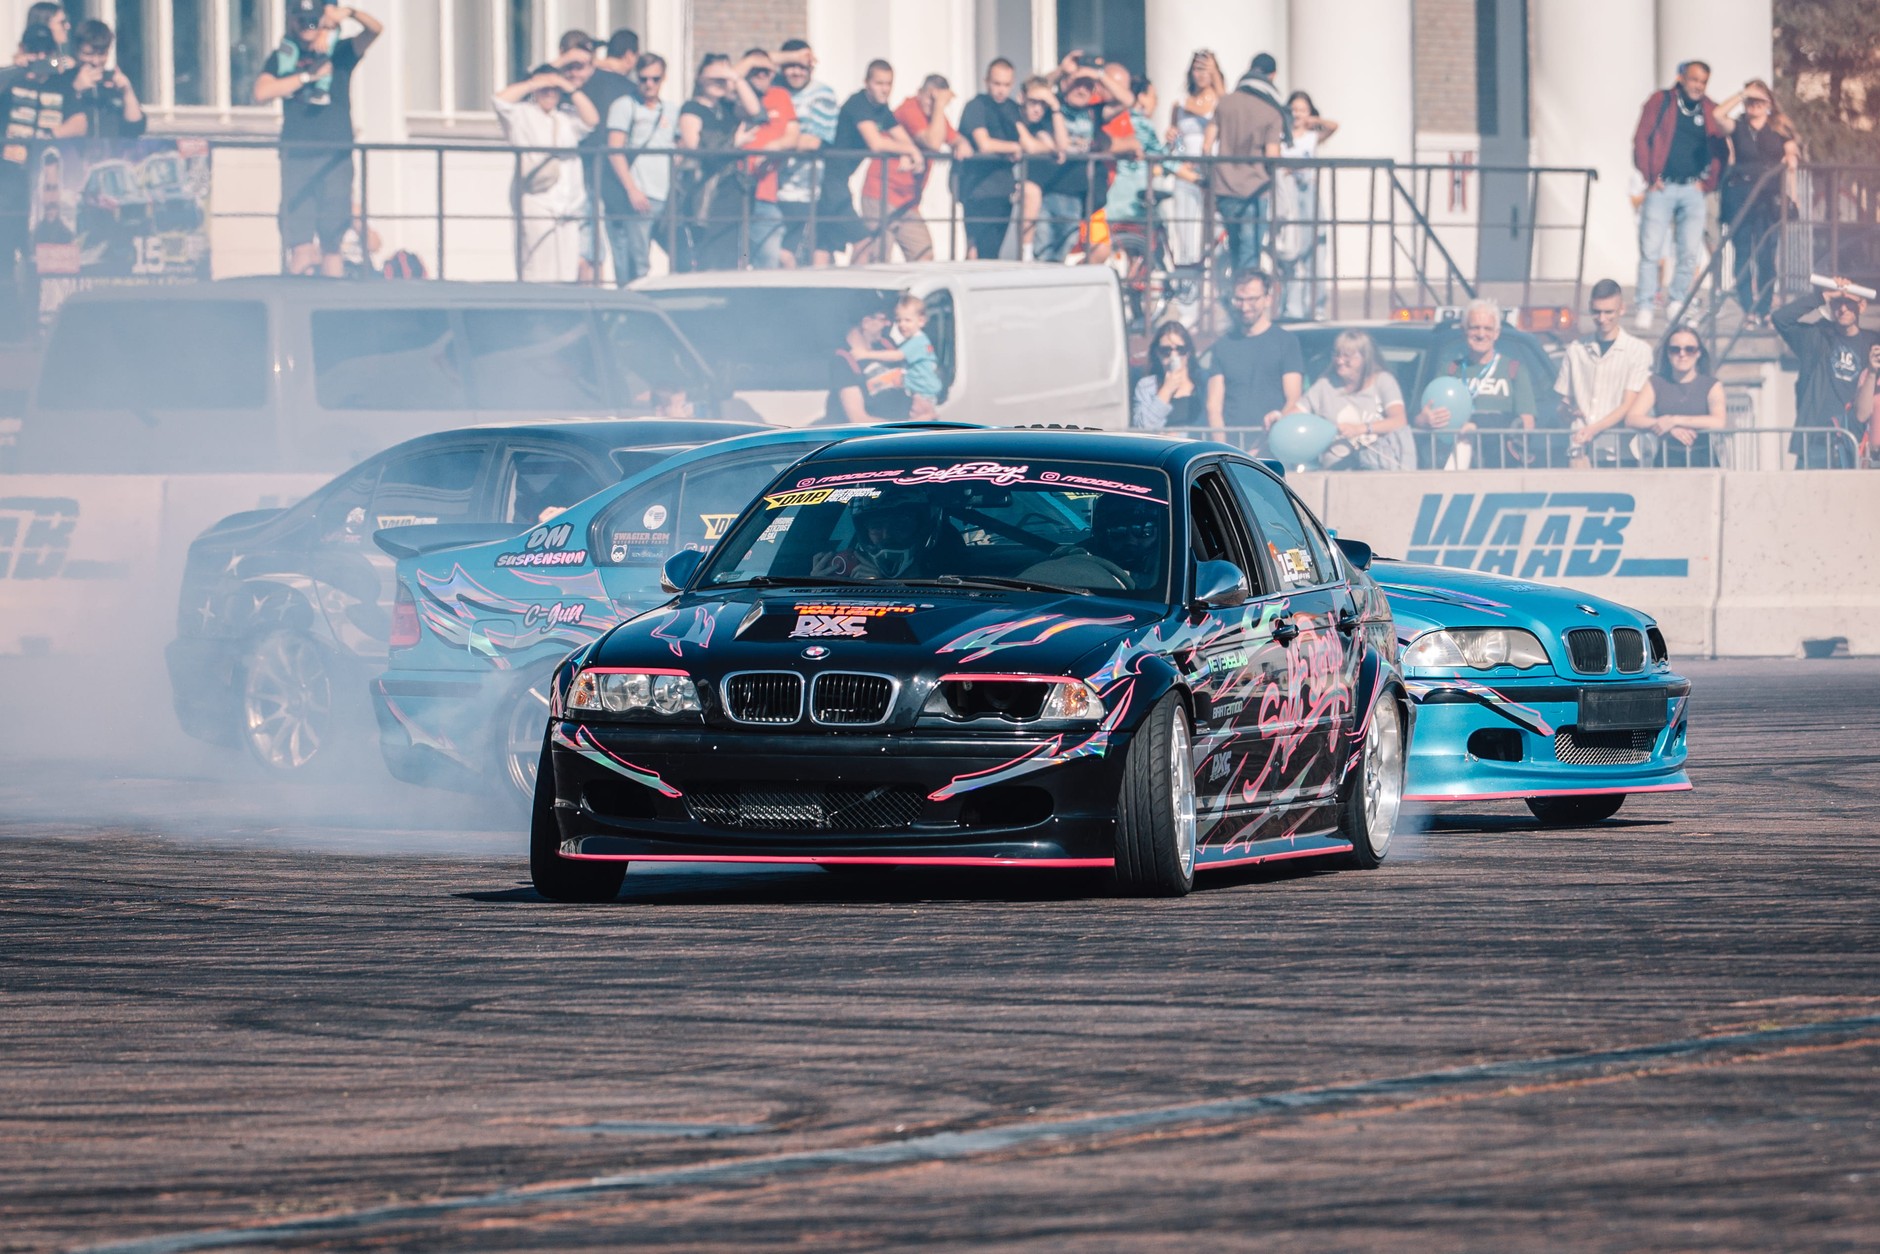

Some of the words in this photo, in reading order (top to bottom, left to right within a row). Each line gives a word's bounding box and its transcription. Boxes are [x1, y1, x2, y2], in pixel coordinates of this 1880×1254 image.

[900, 464, 966, 482] Soft
[779, 490, 827, 506] DMP
[526, 524, 573, 550] DM
[496, 550, 586, 566] SUSPENSION
